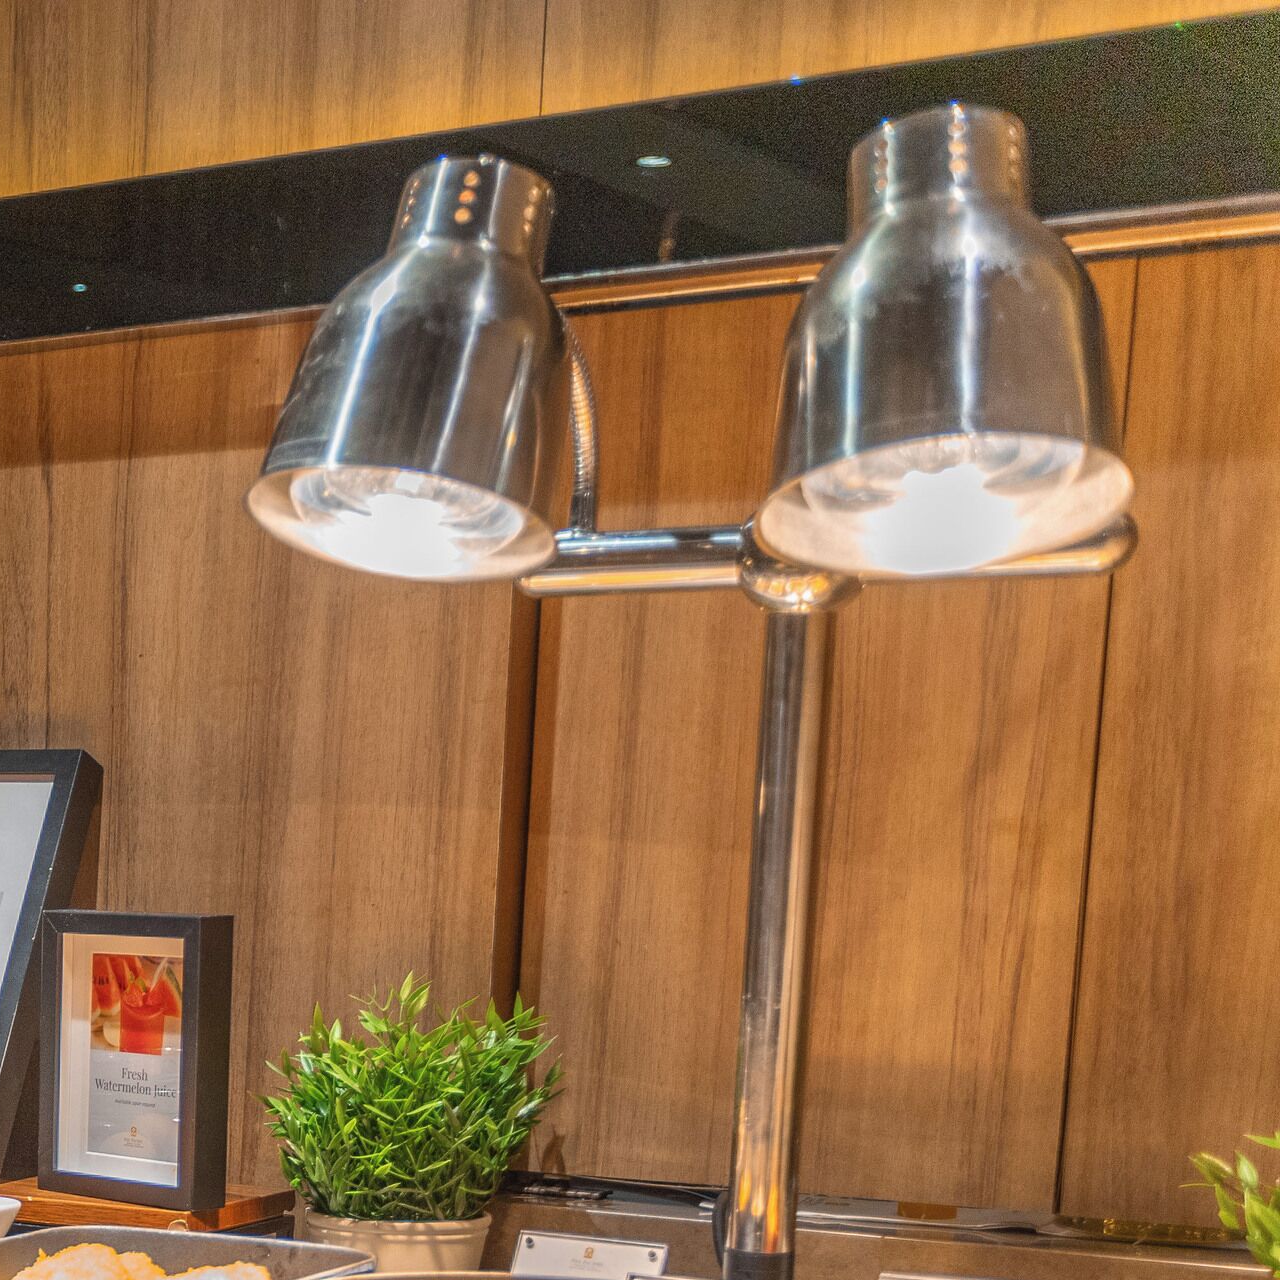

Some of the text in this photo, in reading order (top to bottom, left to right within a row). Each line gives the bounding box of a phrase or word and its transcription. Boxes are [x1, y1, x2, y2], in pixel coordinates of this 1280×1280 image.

[121, 1067, 149, 1081] Fresh
[95, 1078, 177, 1098] Watermelon Juice
